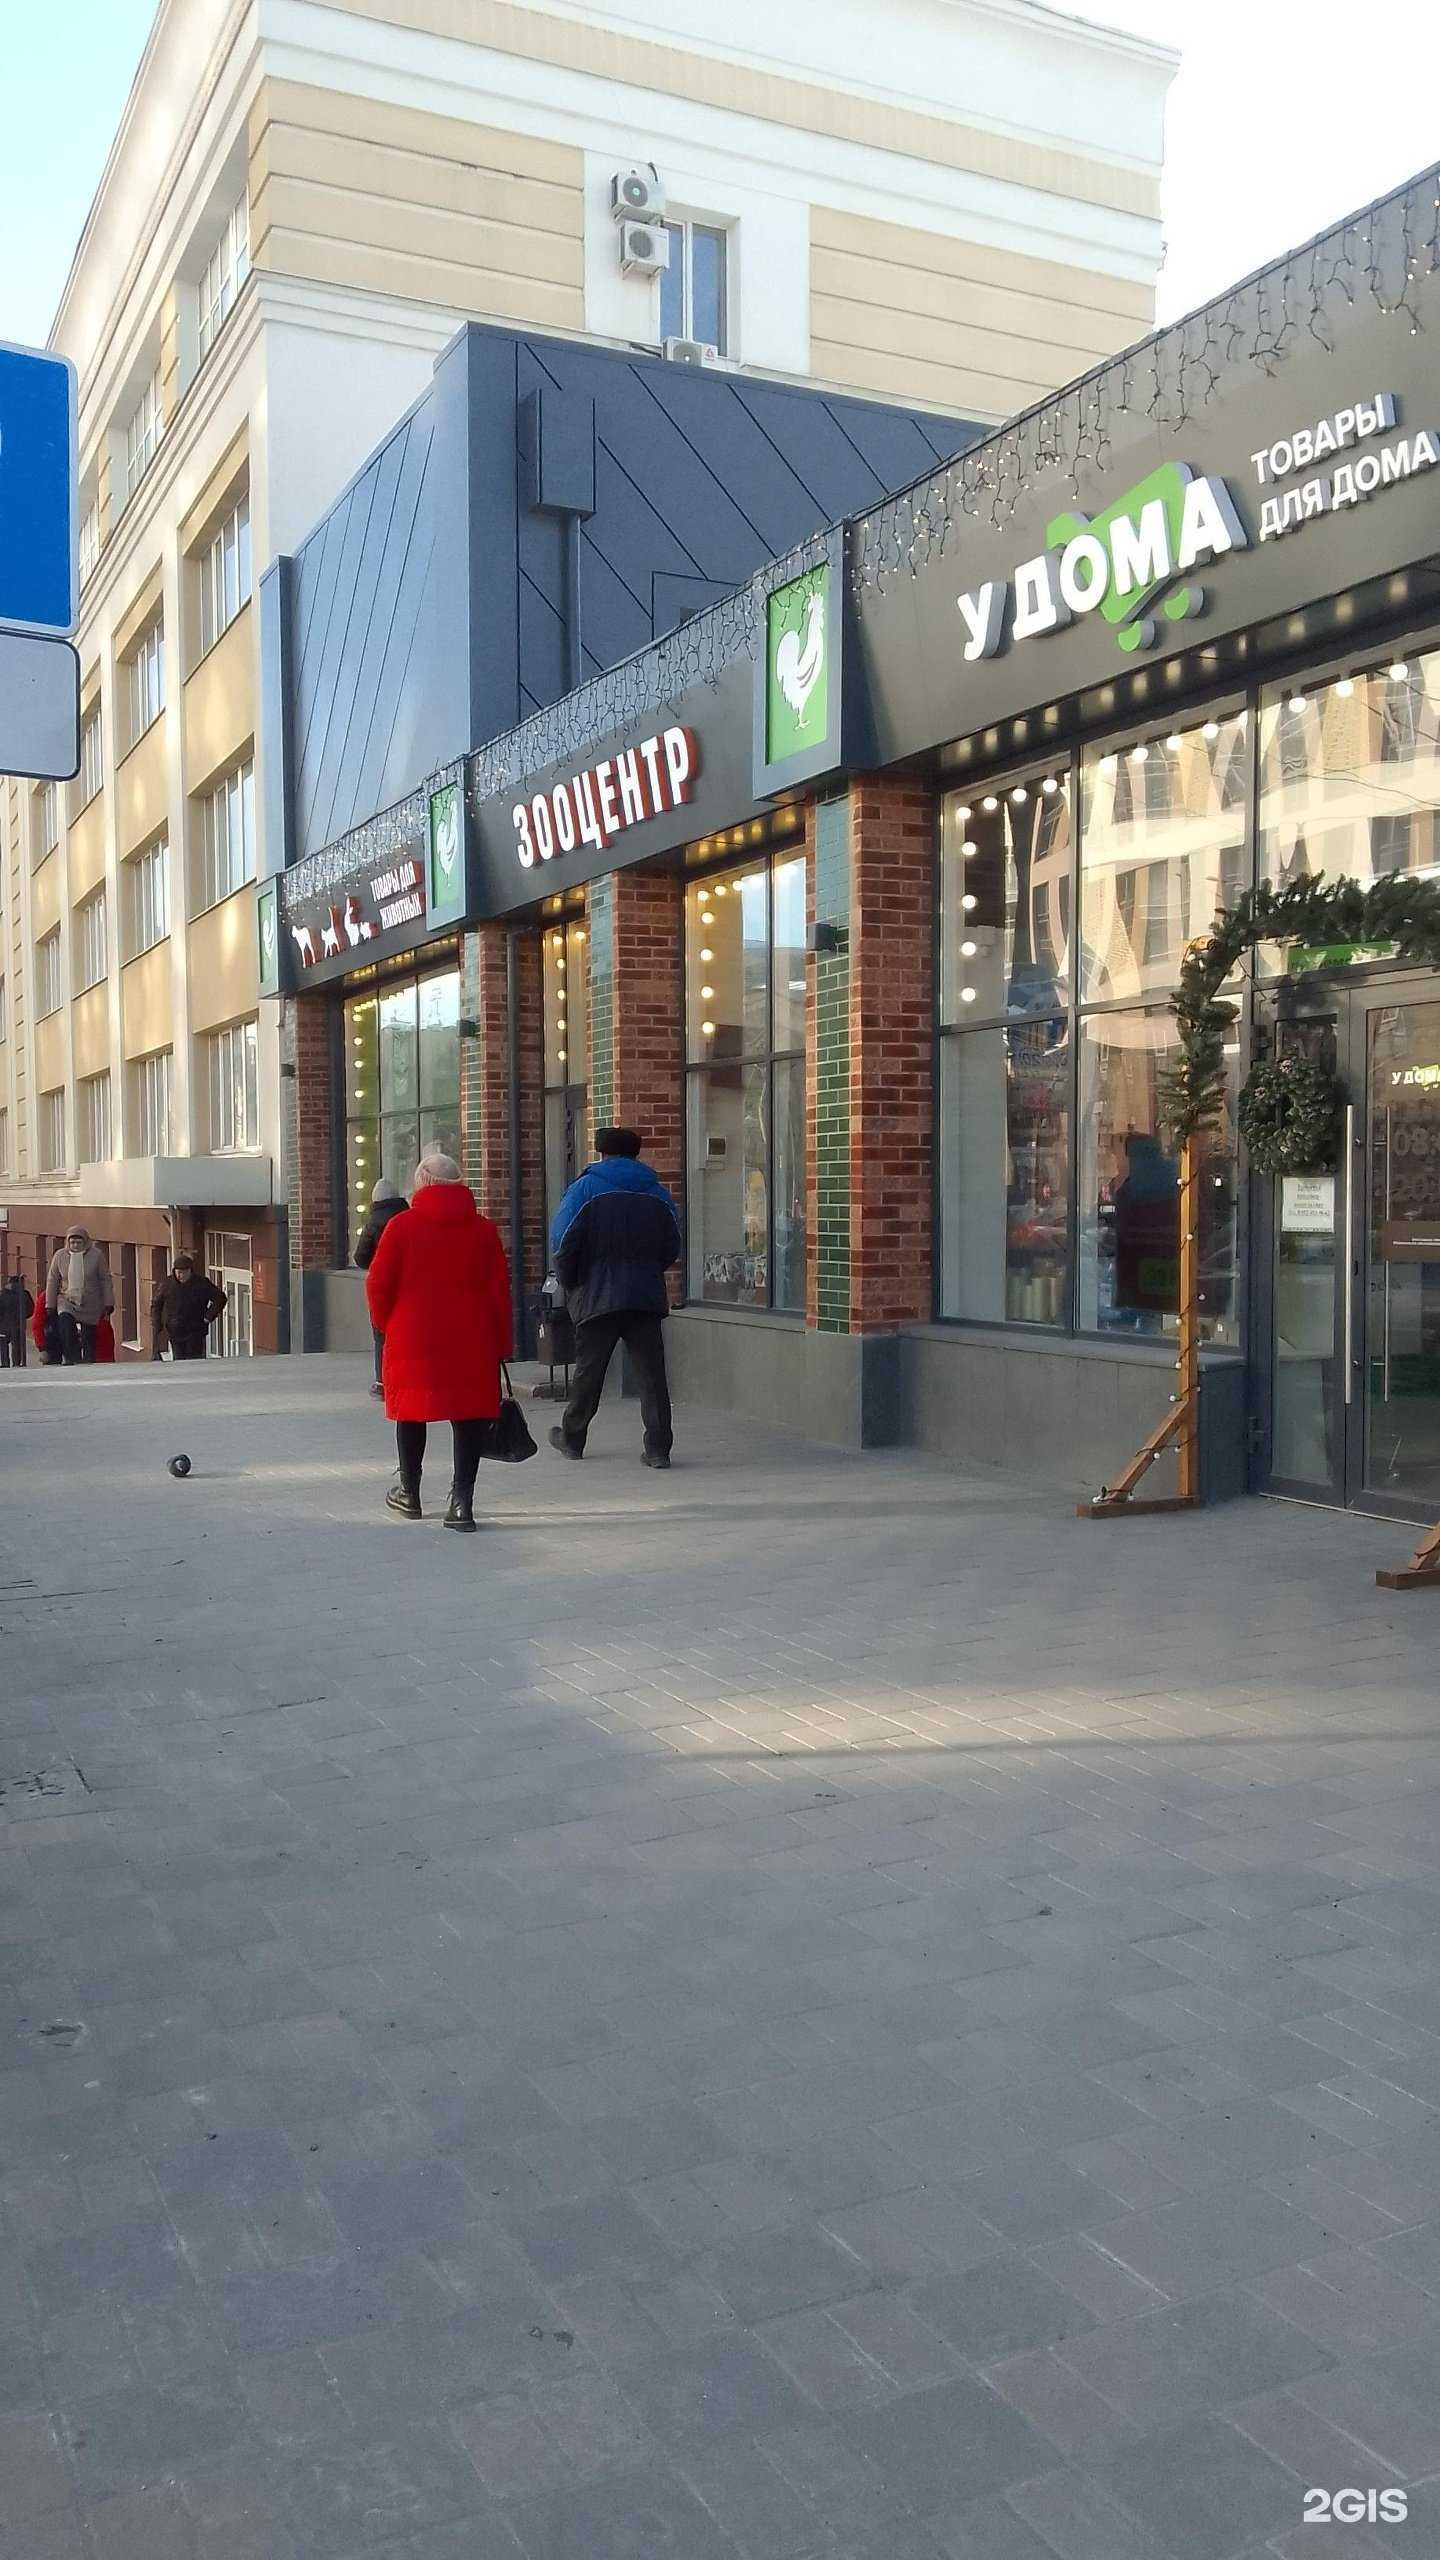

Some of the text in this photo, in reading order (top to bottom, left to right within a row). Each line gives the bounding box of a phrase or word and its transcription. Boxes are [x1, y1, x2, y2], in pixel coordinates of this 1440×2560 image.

[1250, 393, 1387, 484] ТОВАРЫ
[1259, 431, 1437, 542] ДЛЯ ДОМА
[511, 725, 693, 870] ЗООЦЕНТР
[370, 860, 417, 902] ТОВАРЫ ДЛЯ
[379, 892, 423, 930] ЖИВОТНЫХ
